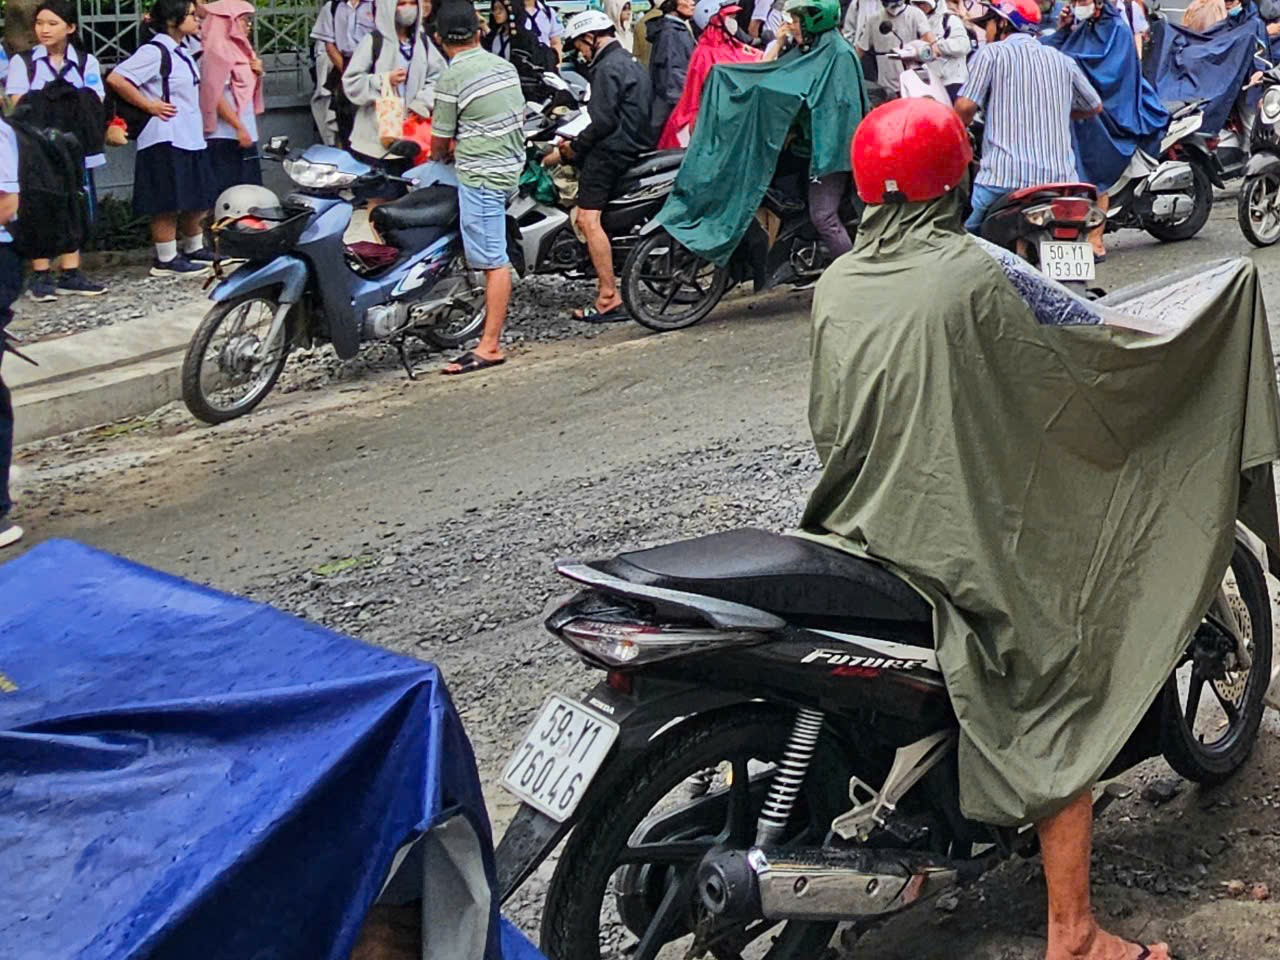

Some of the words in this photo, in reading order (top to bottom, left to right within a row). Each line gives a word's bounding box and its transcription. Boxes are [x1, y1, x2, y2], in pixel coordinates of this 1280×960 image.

[1046, 261, 1090, 278] 153.07
[800, 648, 928, 670] FUTURE
[540, 703, 602, 764] 59-Y1
[507, 742, 583, 811] 760.46
